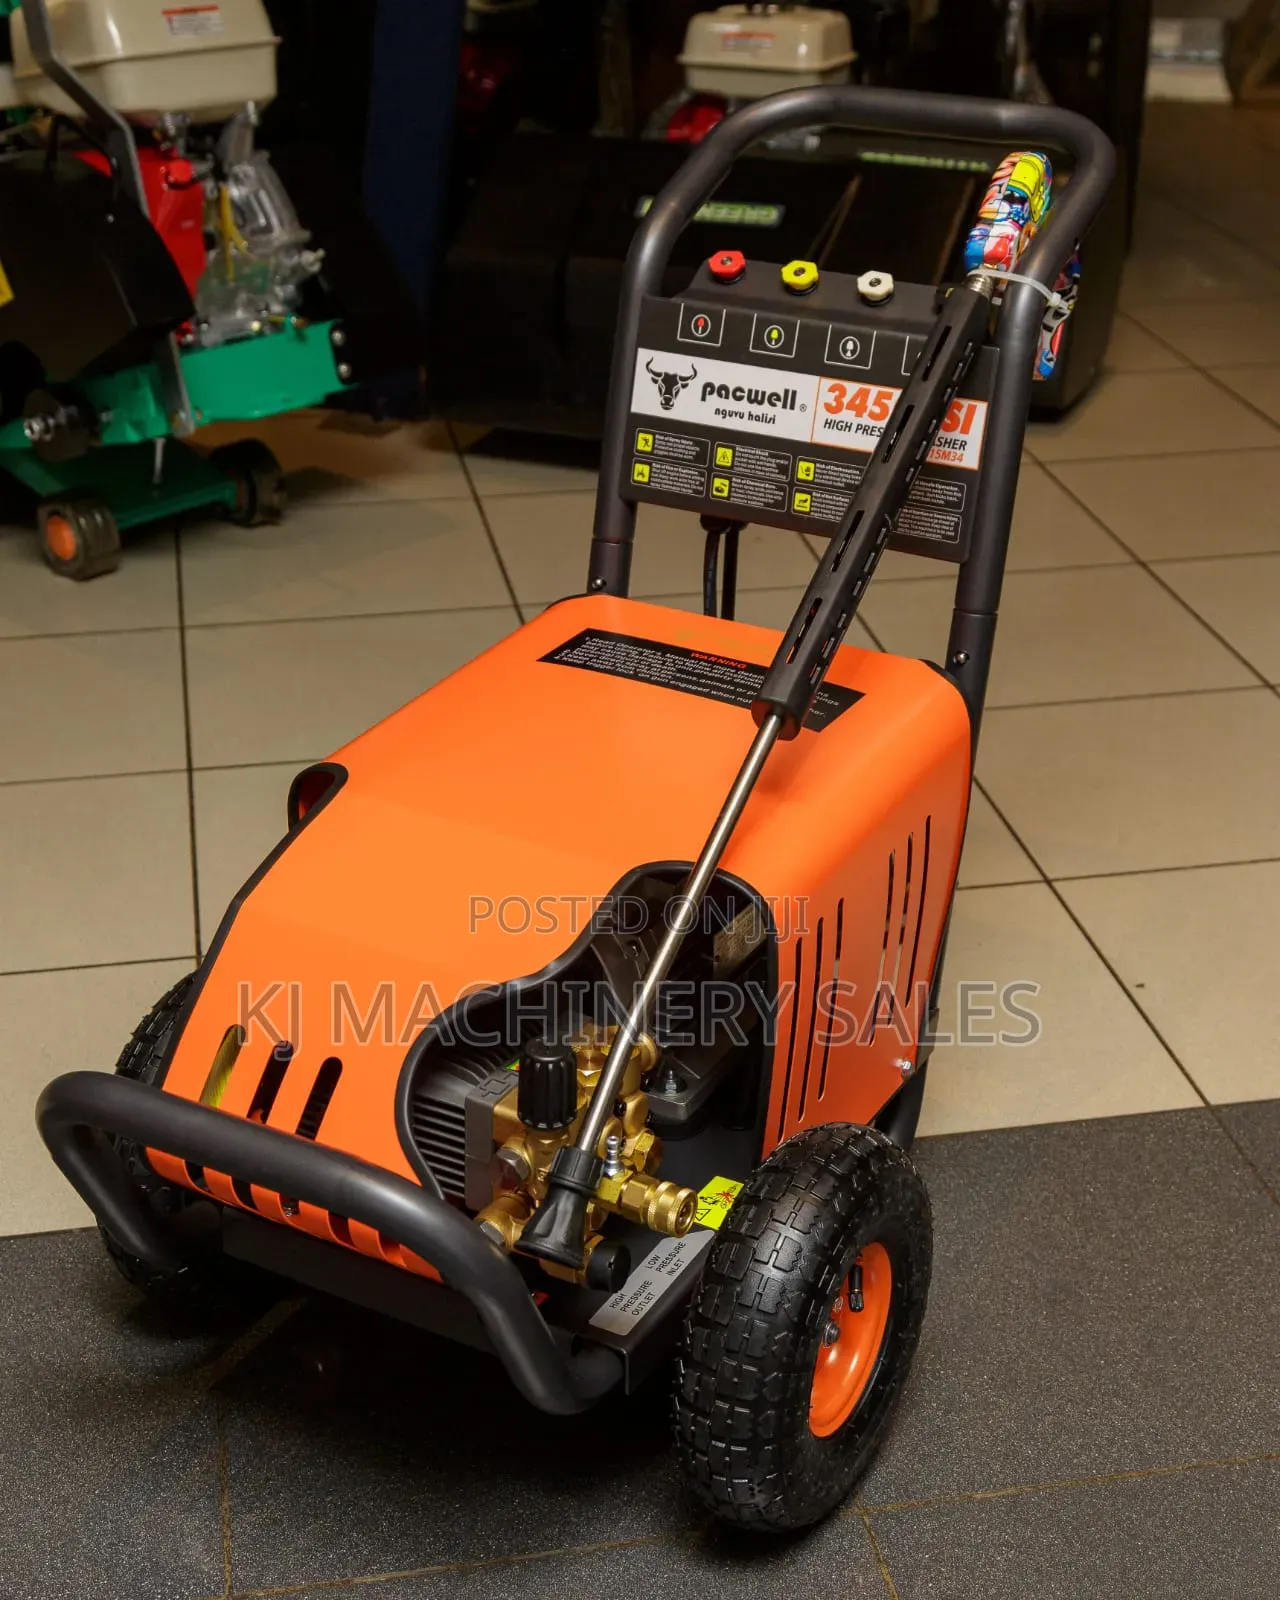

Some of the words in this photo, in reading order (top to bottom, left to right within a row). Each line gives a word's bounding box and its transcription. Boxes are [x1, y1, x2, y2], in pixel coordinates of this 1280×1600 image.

[700, 382, 798, 410] pacwell
[714, 407, 744, 420] nguvu
[748, 411, 776, 424] halisi
[941, 400, 978, 434] SI
[823, 418, 852, 432] HIGH
[855, 423, 885, 438] PRES
[932, 436, 968, 450] SHER
[691, 652, 747, 668] WARNING
[646, 1254, 662, 1269] LOW
[656, 1242, 686, 1272] PRESSURE
[666, 1258, 685, 1276] INLET
[609, 1293, 626, 1308] HIGH
[620, 1280, 652, 1312] PRESSURE
[632, 1292, 656, 1316] OUTLET
